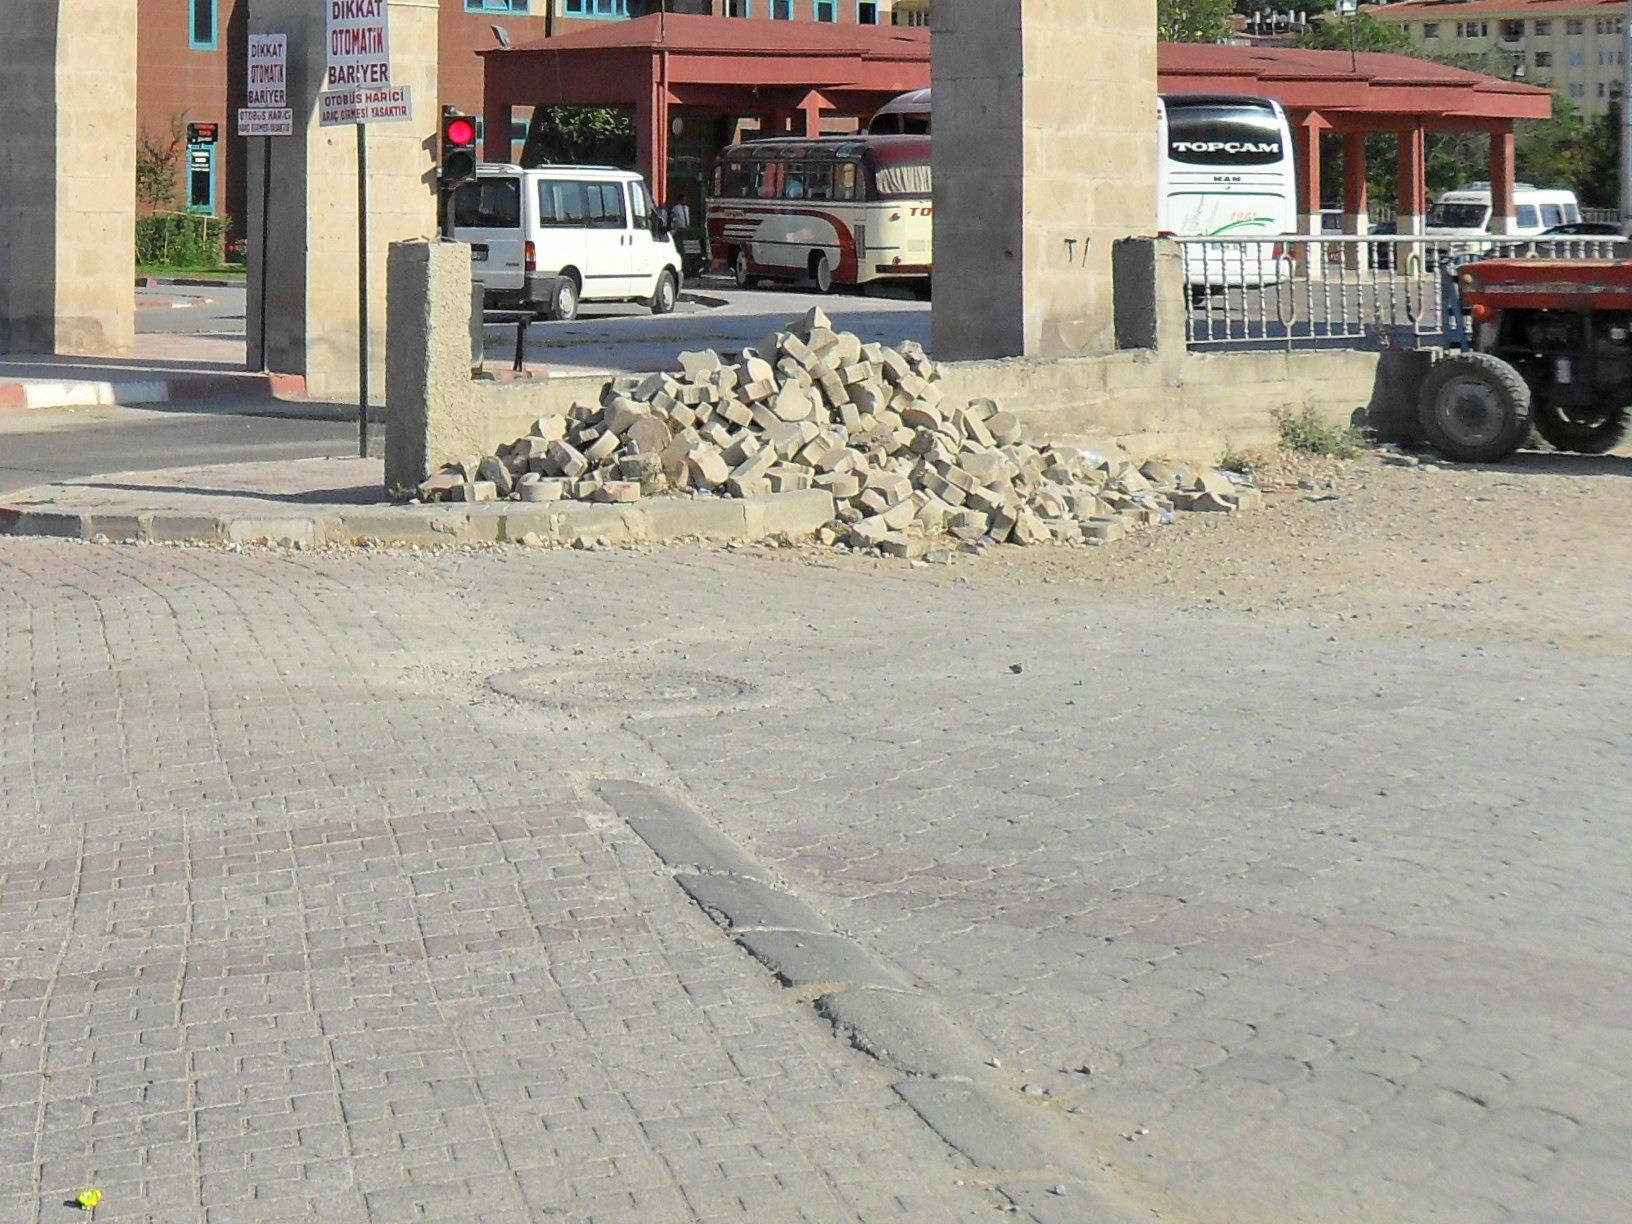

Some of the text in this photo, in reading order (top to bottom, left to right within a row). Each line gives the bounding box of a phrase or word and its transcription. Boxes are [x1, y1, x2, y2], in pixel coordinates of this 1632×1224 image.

[251, 41, 283, 58] DİKKAT
[331, 27, 384, 56] OTOMATİK
[251, 63, 284, 84] OTOMATİK
[328, 60, 389, 84] BARİYER
[248, 87, 285, 104] BARİYER
[324, 88, 404, 107] OTOBÜS HARİCİ
[371, 105, 407, 118] YASAKTIR
[1172, 142, 1279, 154] TOPÇAM
